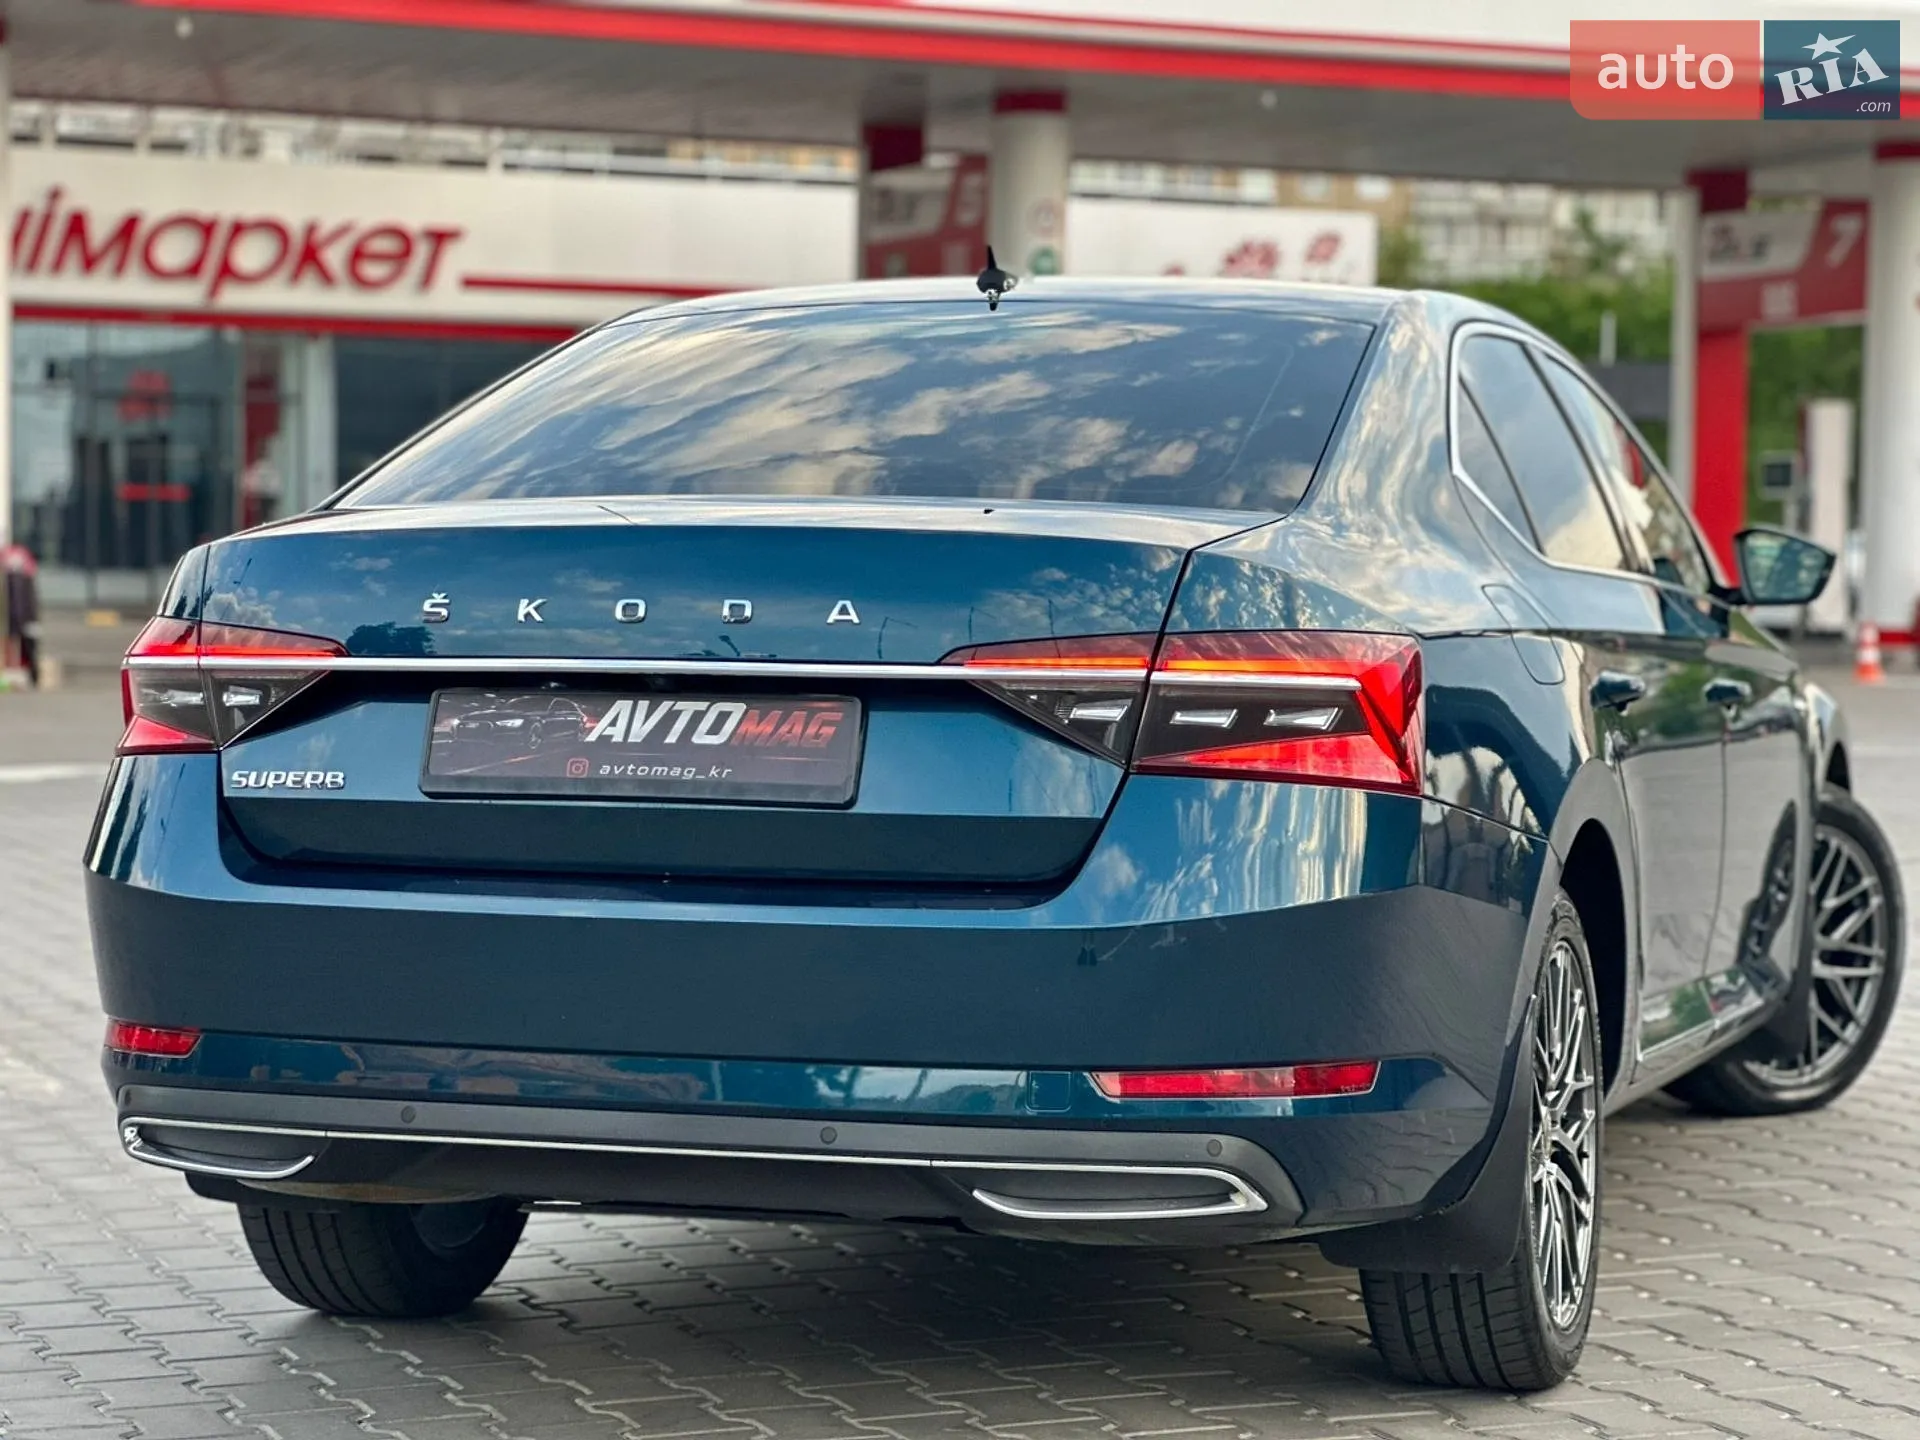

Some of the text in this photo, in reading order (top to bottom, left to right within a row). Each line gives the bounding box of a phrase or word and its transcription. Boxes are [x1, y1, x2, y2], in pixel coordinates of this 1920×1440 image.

[422, 592, 862, 625] ŠKODA
[585, 699, 842, 749] AVTOMAG
[230, 769, 346, 790] SUPERB
[599, 761, 733, 780] avtomag_kr
